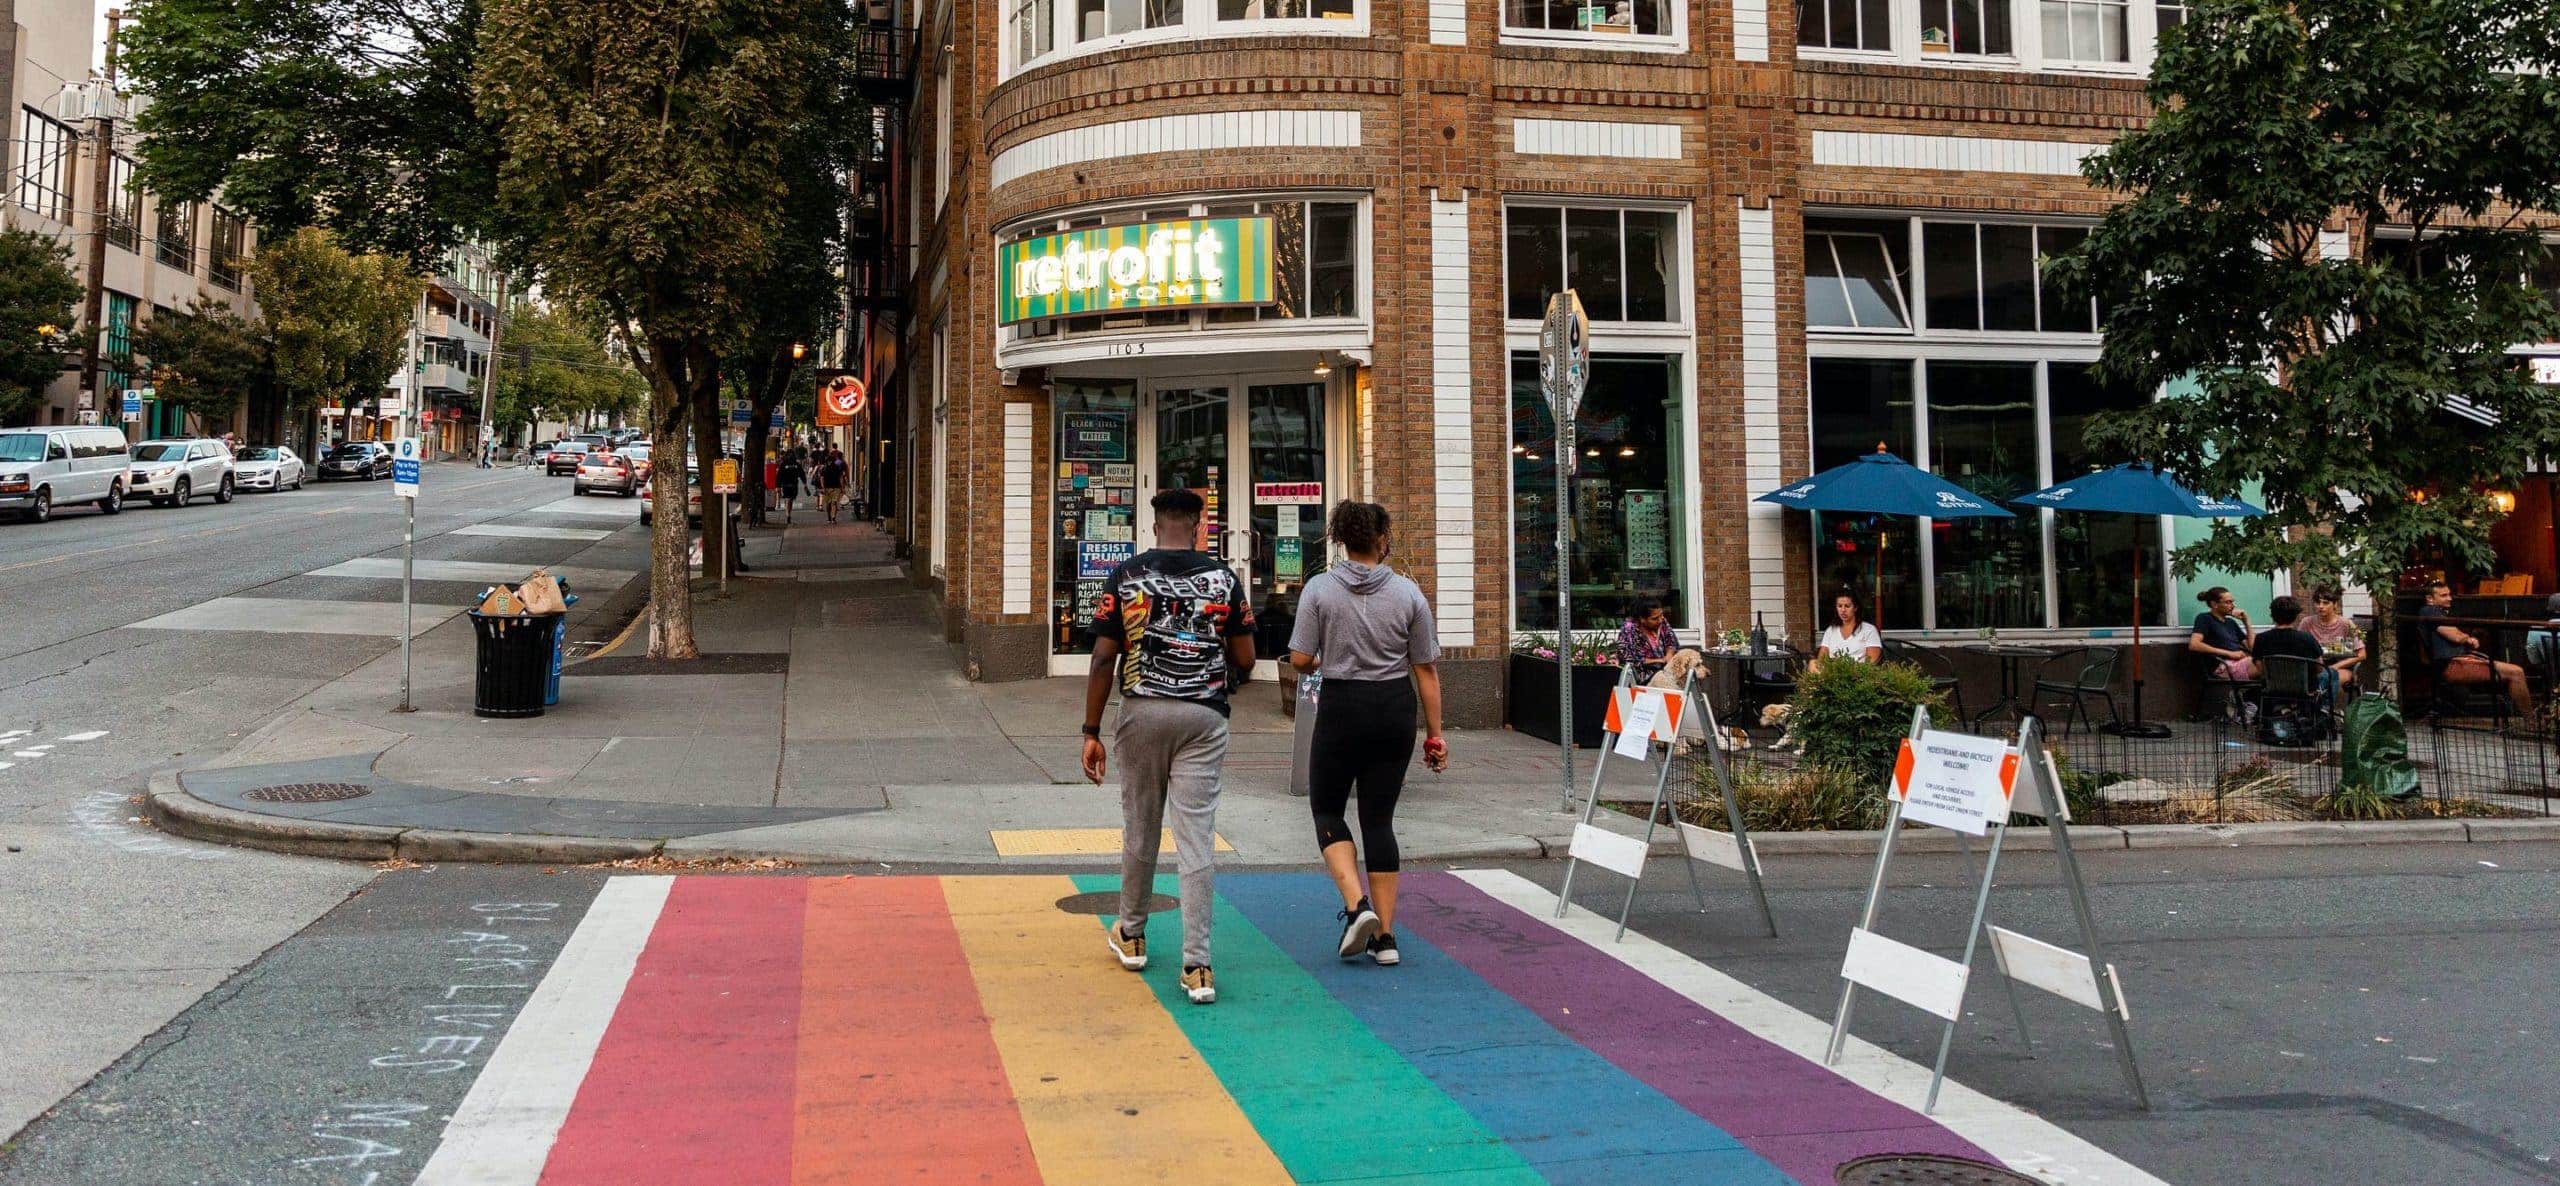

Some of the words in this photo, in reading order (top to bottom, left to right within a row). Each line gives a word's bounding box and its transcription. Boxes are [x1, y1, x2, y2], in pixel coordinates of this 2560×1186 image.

[1016, 228, 1223, 298] retrofit
[1109, 284, 1223, 301] HOME
[1109, 343, 1145, 355] 1103
[1071, 420, 1093, 428] BLACK
[1081, 432, 1110, 441] MATTER
[1108, 467, 1119, 475] NOT
[1120, 467, 1130, 475] MY
[1256, 484, 1320, 496] retrofit
[1086, 544, 1127, 552] RESIST
[1082, 553, 1132, 561] TRUMP
[1078, 582, 1104, 590] NATIVE
[1118, 575, 1215, 600] STEEL
[1078, 590, 1104, 599] RIGHTS
[1078, 599, 1091, 607] ARE
[1078, 607, 1097, 615] HUMA
[1078, 616, 1093, 624] RIG
[1143, 669, 1176, 685] MONTE
[447, 902, 560, 972] BLACK
[369, 983, 530, 1074] LIVES
